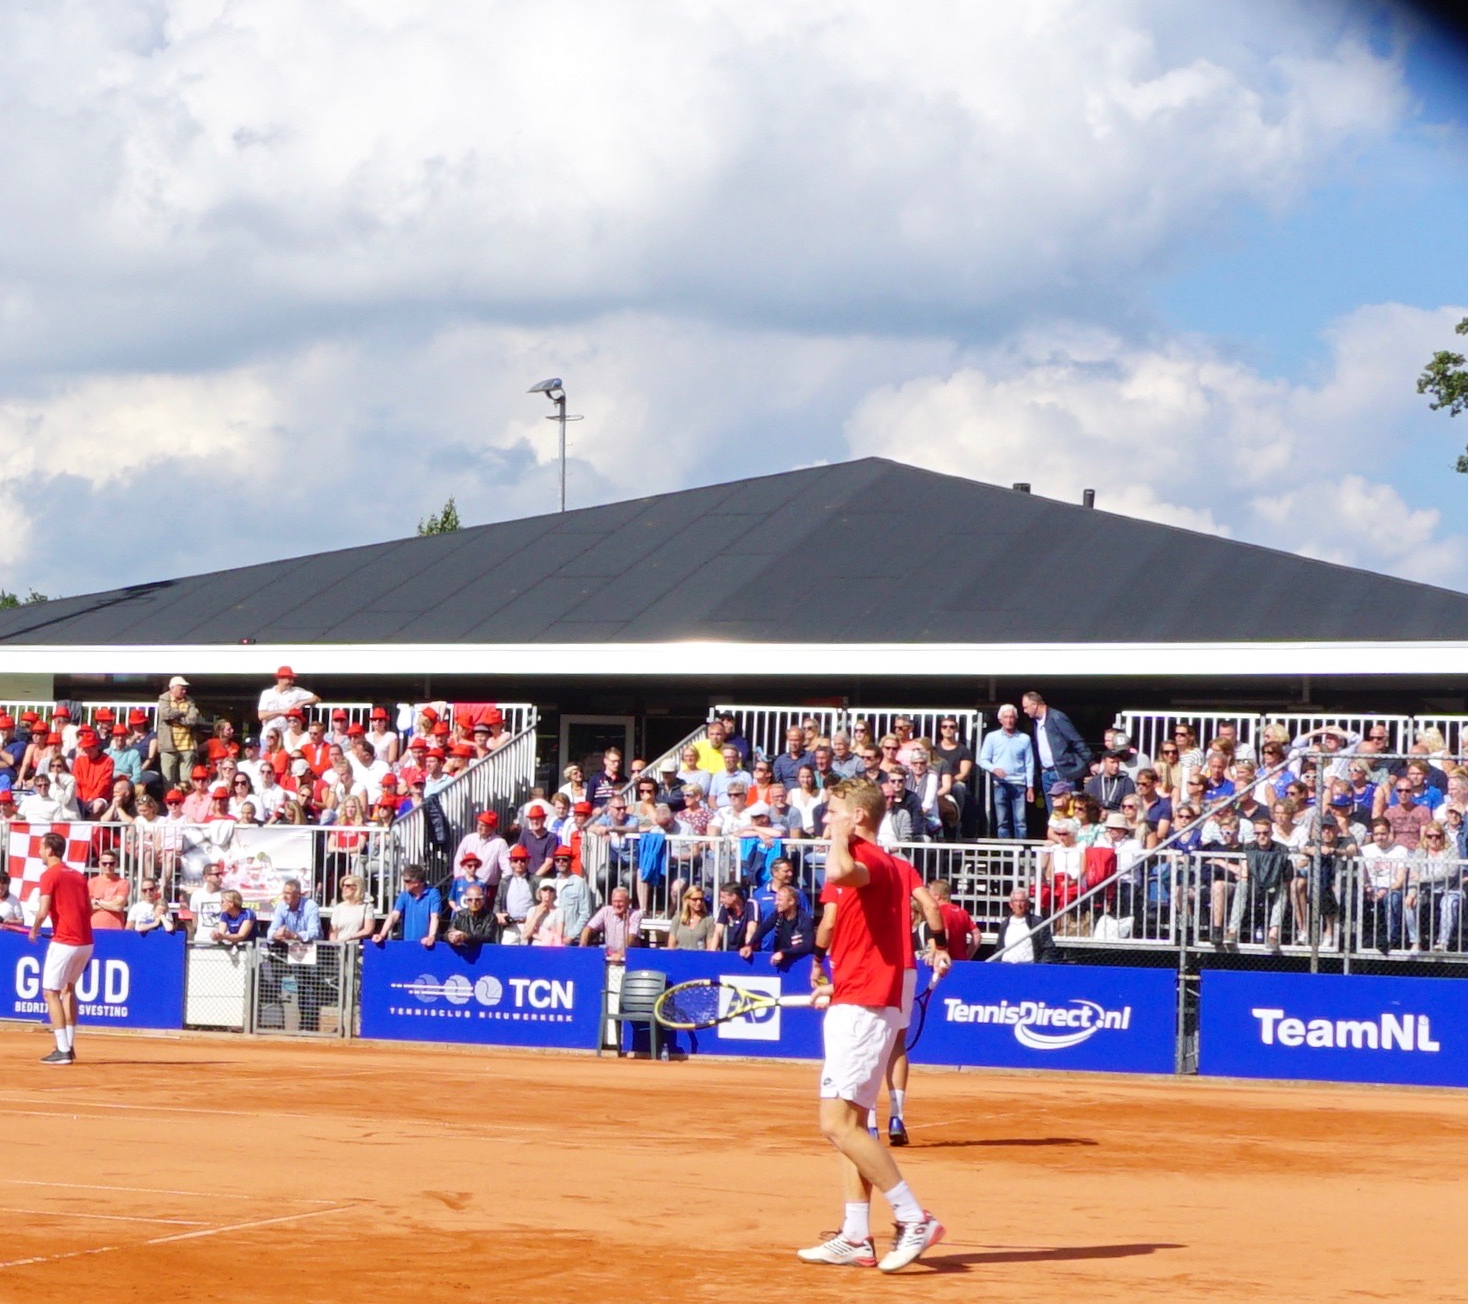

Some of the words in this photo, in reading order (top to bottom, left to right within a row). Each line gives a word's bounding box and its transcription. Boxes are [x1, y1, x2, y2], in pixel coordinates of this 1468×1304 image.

[17, 956, 129, 1004] GUD
[509, 978, 574, 1009] TCN
[390, 1007, 471, 1019] TENNISCLUB
[479, 1011, 573, 1023] NIEUWERKERK
[944, 998, 1131, 1031] TennisDirect.nl
[1252, 1008, 1440, 1052] TeamNL
